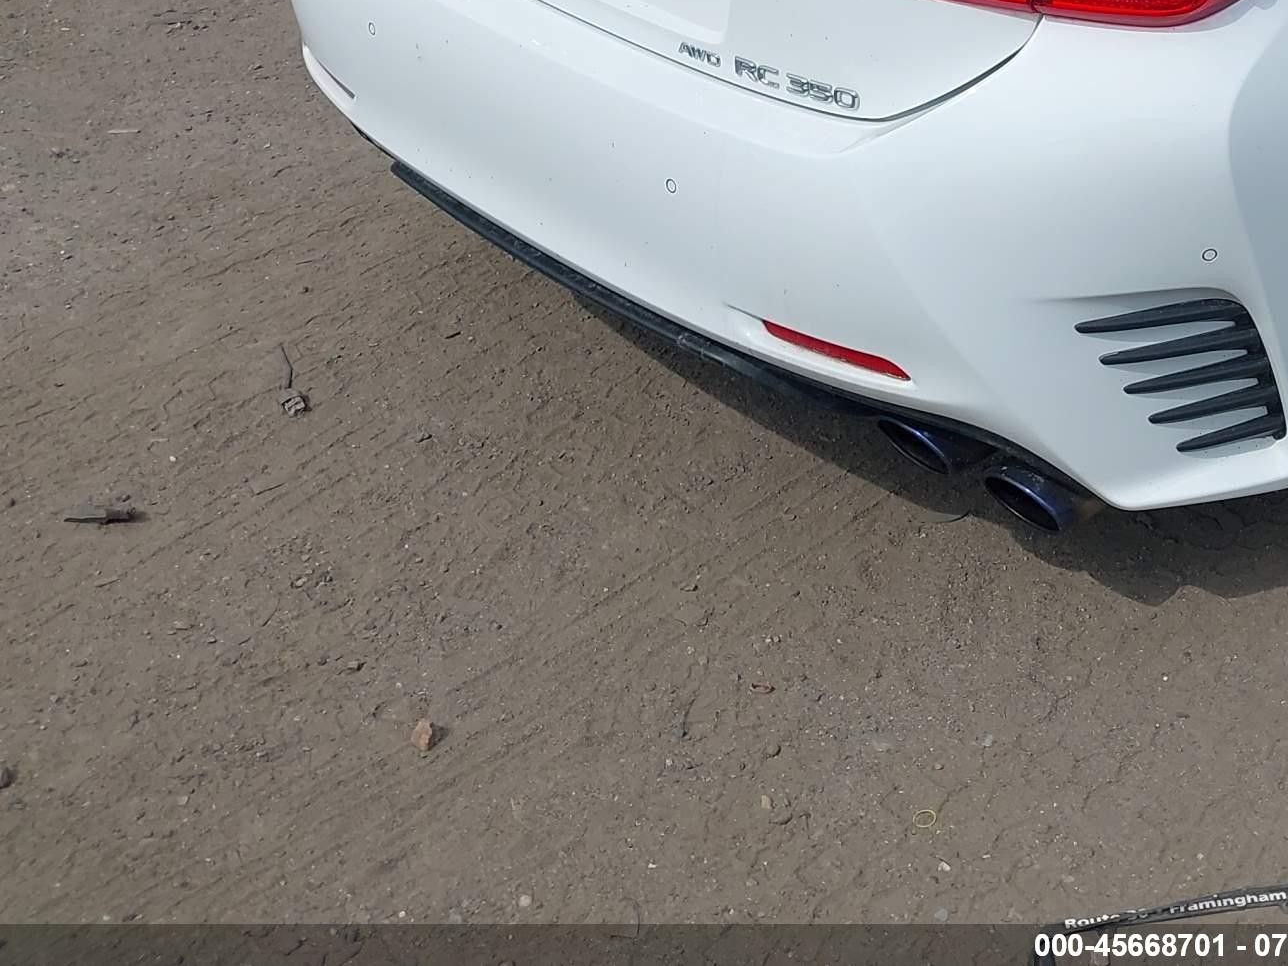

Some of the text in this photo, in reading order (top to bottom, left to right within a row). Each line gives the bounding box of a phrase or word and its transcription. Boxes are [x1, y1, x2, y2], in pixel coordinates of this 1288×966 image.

[678, 41, 861, 111] AWD RC 350
